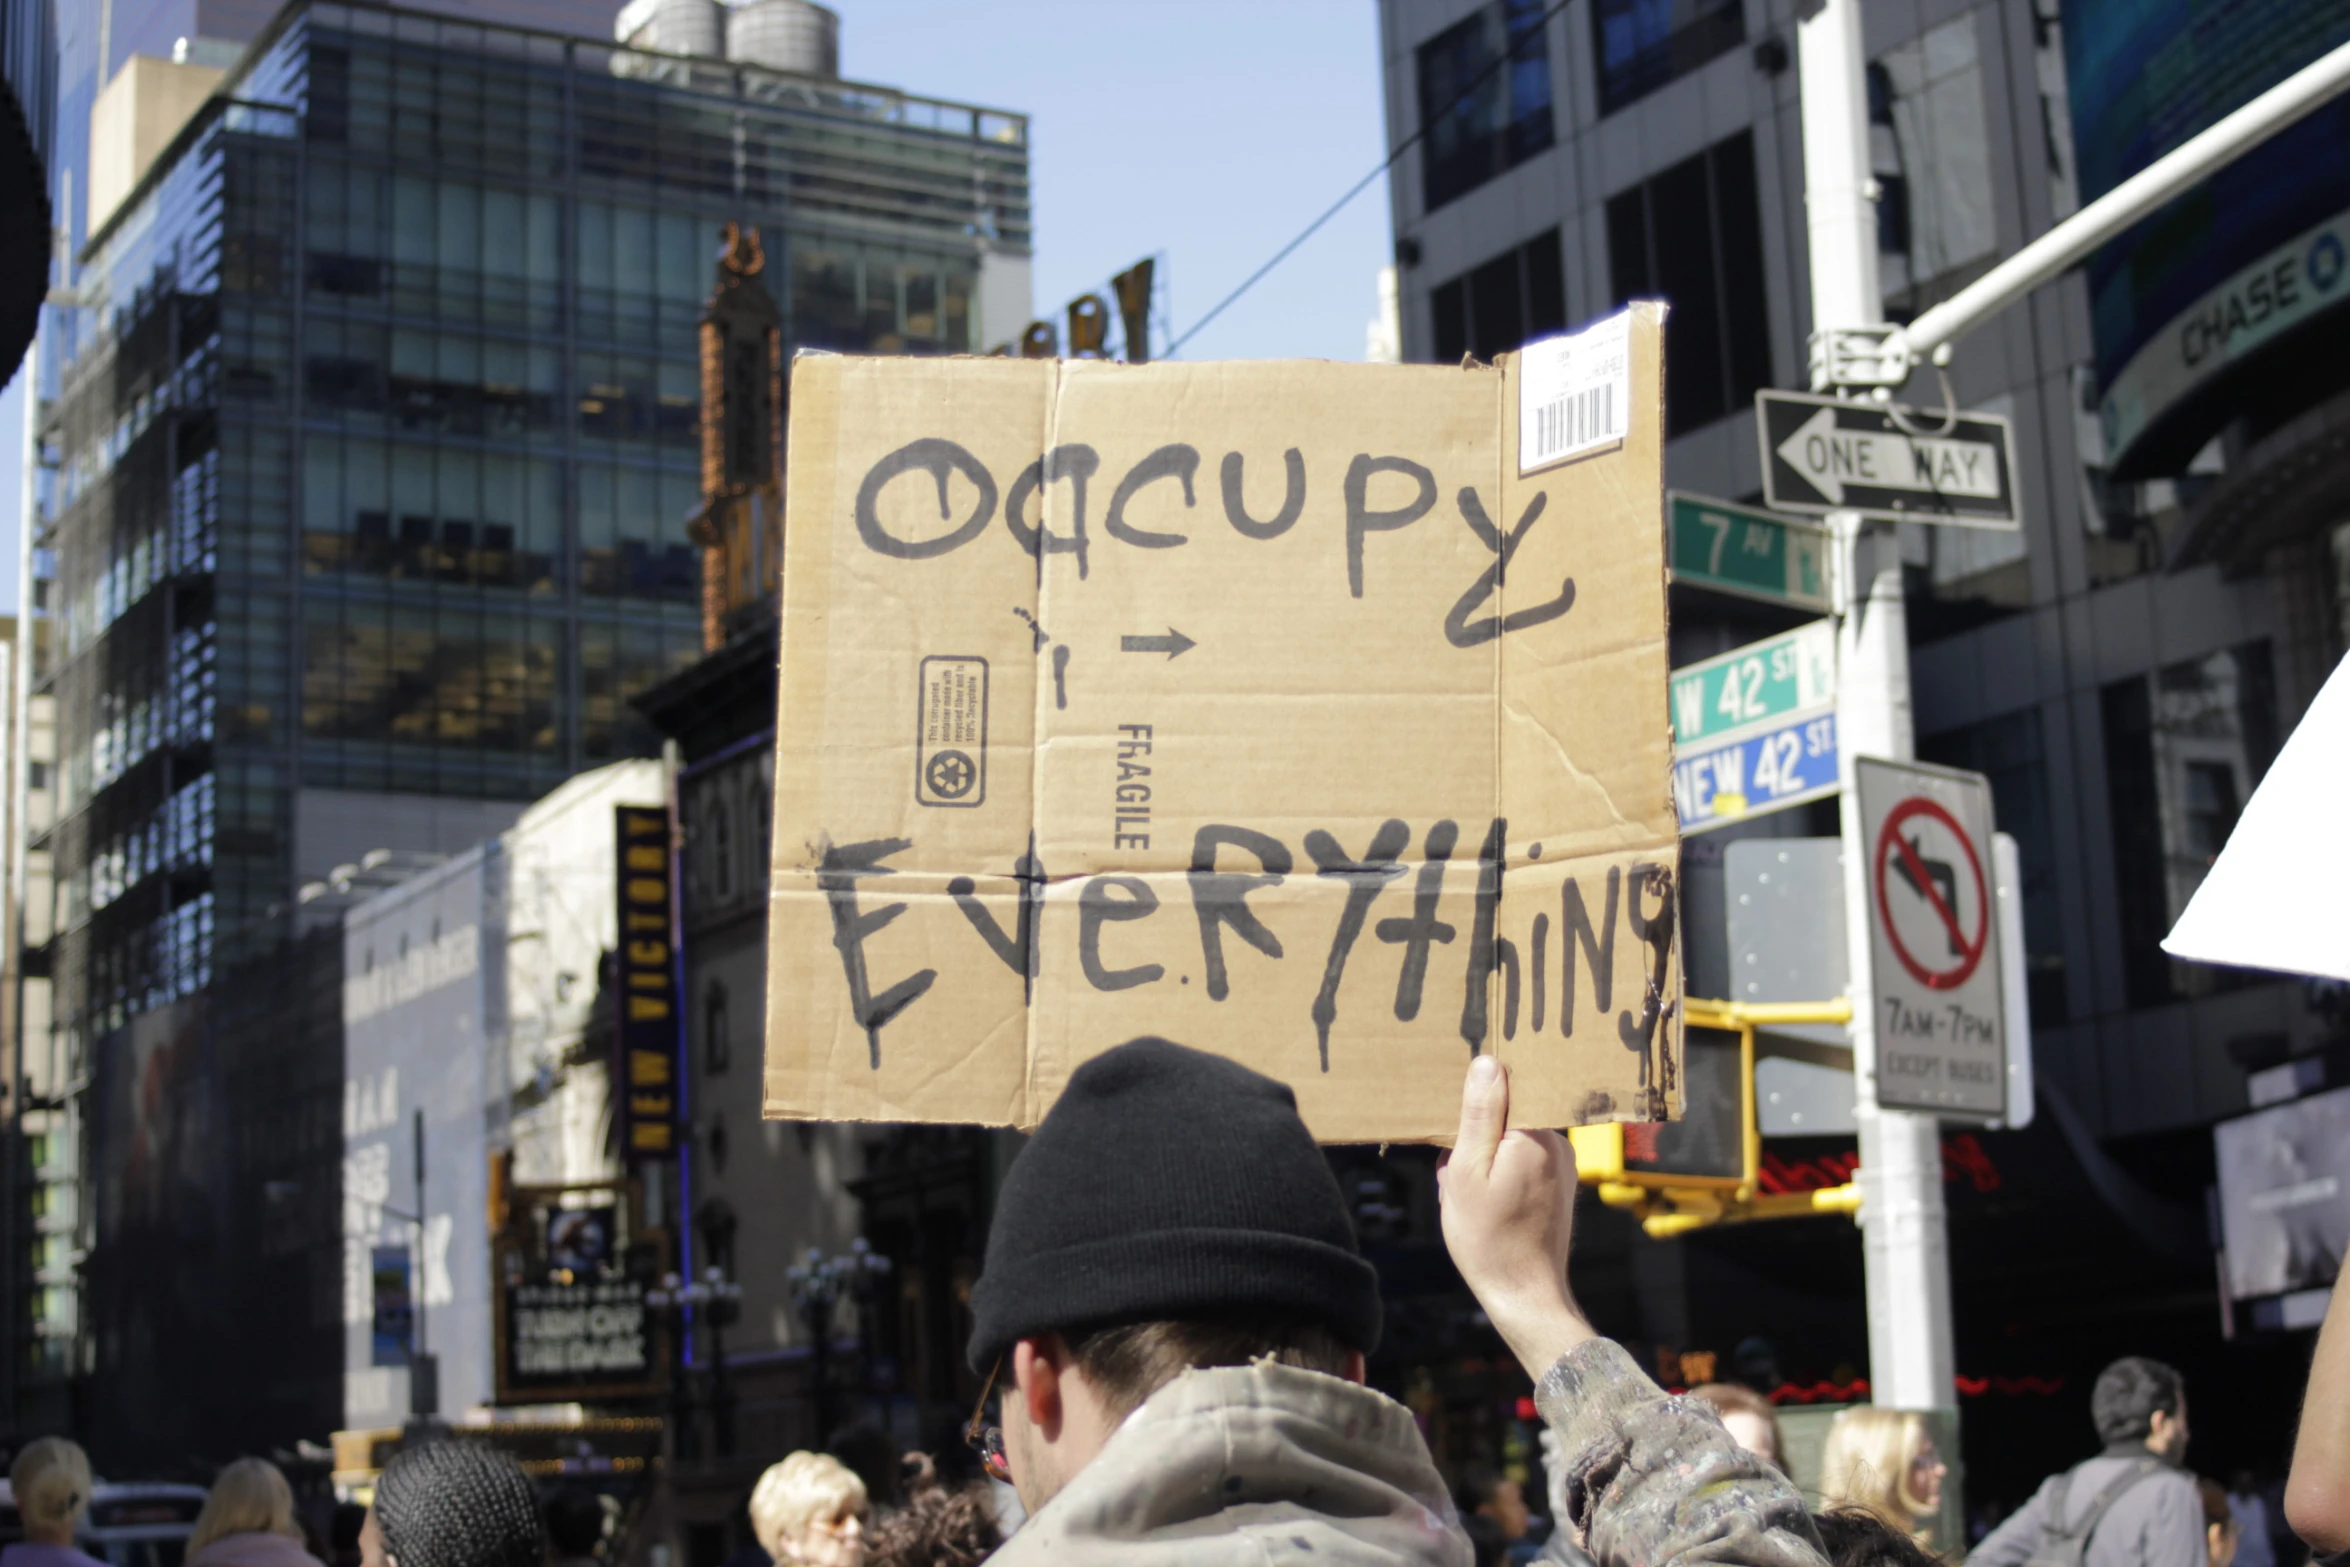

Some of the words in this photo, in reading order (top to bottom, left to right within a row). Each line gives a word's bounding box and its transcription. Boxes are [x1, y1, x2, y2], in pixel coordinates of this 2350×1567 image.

[2180, 256, 2300, 369] CHASE
[1805, 433, 1878, 479] ONE
[1911, 445, 1981, 486] WAY
[1699, 512, 1731, 576] 7
[1743, 524, 1775, 558] AV
[929, 682, 941, 723] corrugated
[942, 686, 952, 707] made
[955, 673, 965, 689] and
[1674, 676, 1704, 740] W
[1717, 656, 1768, 723] 42
[1771, 643, 1799, 682] ST
[941, 708, 951, 742] container
[953, 710, 965, 742] recycled
[1114, 724, 1153, 850] FRAGILE
[1675, 746, 1746, 823] NEW
[1753, 728, 1806, 798] 42
[624, 812, 670, 1022] VICTORY
[1884, 997, 1994, 1045] 7AM-7PM
[1886, 1051, 1942, 1078] EXCEPT
[1946, 1055, 1996, 1084] BUSES
[629, 1048, 672, 1151] NEW
